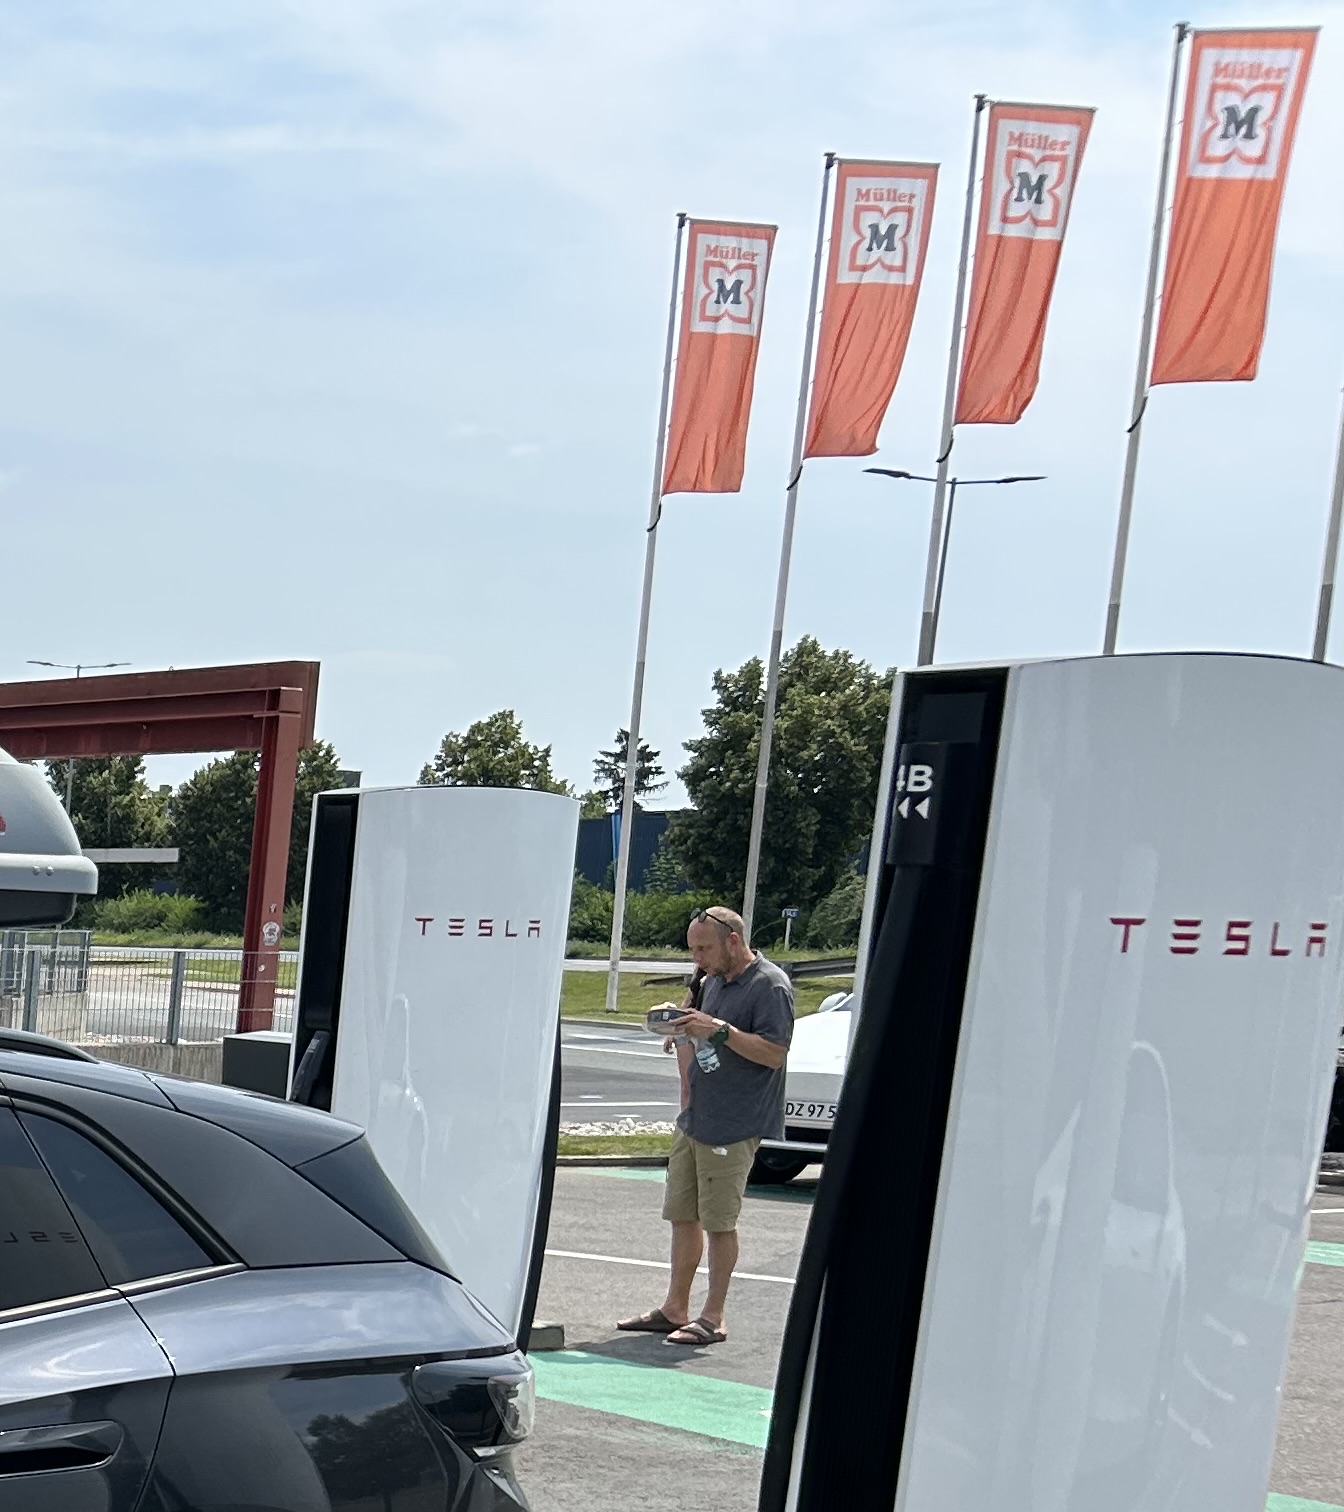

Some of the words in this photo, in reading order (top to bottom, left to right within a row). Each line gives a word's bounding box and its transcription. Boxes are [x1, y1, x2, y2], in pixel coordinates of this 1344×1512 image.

[1218, 104, 1264, 141] M
[855, 187, 916, 204] Müller
[1014, 171, 1048, 205] M
[866, 222, 899, 252] M
[704, 244, 759, 261] Müller
[714, 278, 744, 305] M
[414, 907, 542, 938] TESLA
[1109, 917, 1328, 958] TESLA
[785, 1102, 805, 1117] DZ
[807, 1104, 825, 1118] 97
